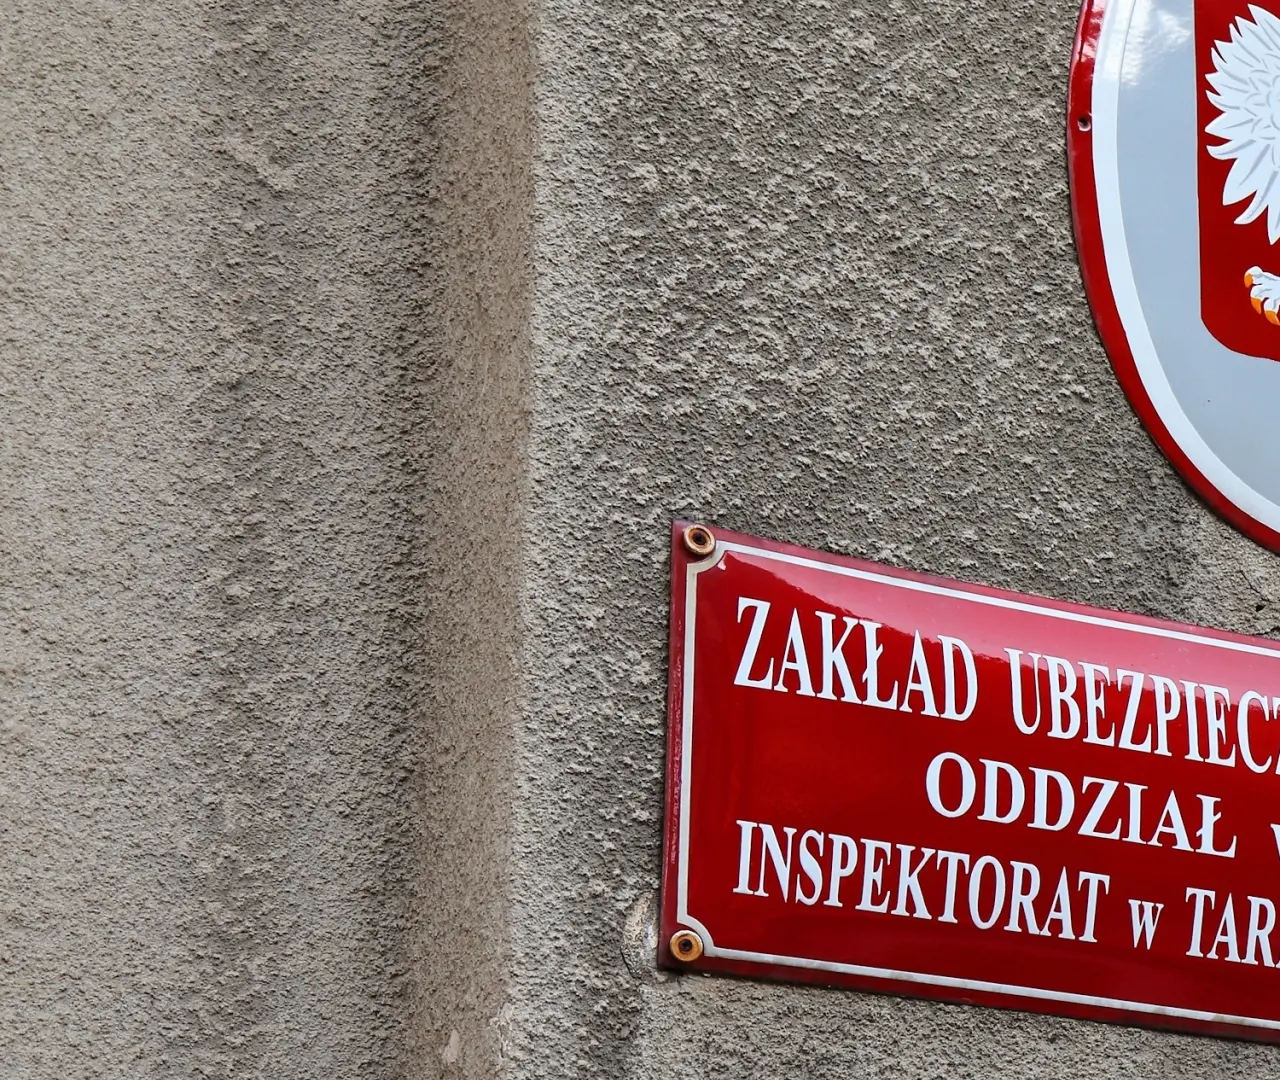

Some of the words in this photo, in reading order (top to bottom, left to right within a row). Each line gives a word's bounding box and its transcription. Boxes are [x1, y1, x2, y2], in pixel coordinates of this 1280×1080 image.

[733, 596, 978, 722] ZAKŁAD
[926, 752, 1237, 858] ODDZIAŁ
[733, 819, 1110, 943] INSPEKTORAT
[1129, 899, 1165, 950] w
